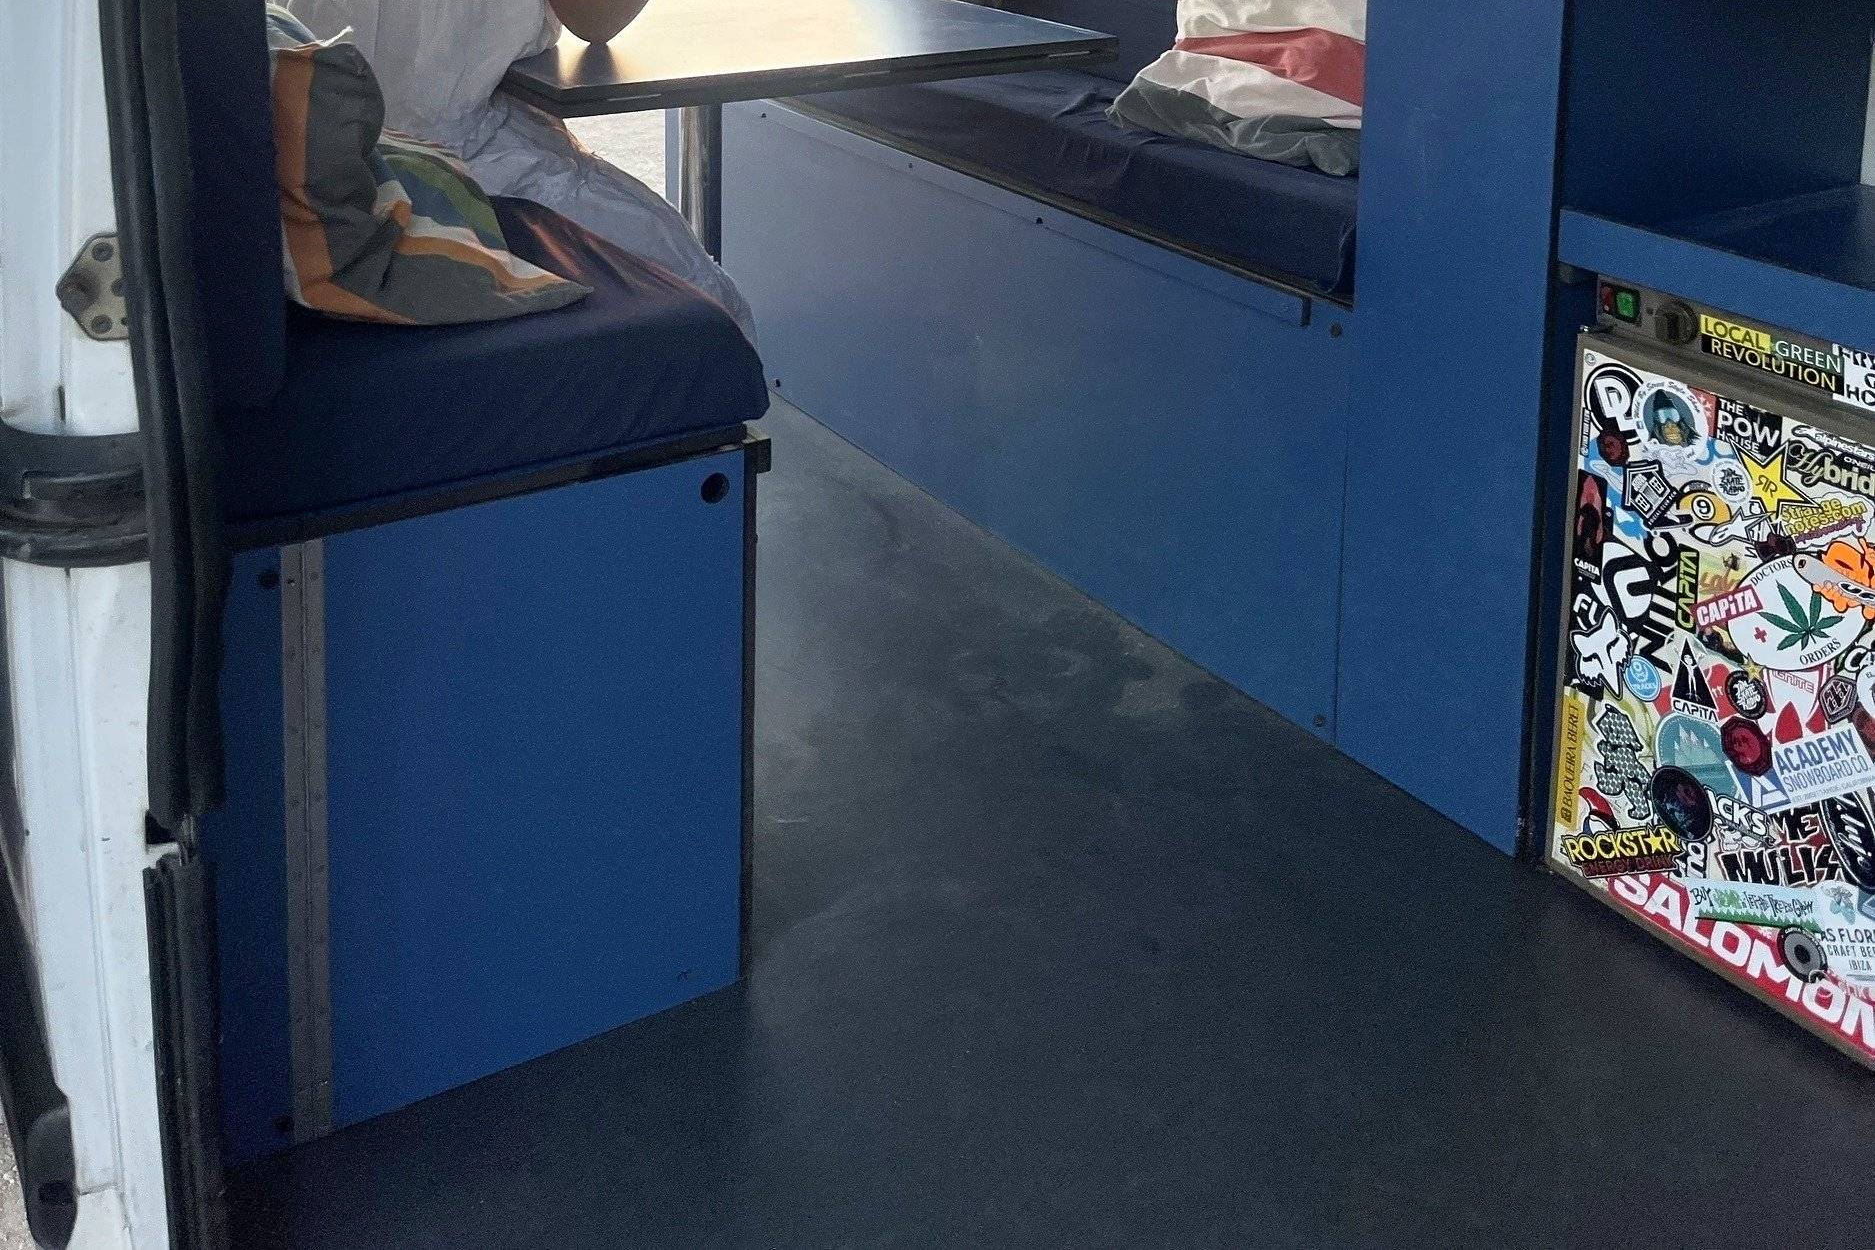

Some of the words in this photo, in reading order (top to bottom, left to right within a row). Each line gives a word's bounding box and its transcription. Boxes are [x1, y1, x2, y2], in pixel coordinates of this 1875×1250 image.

[1704, 317, 1766, 351] LOCAL
[1775, 340, 1841, 373] GREEN
[1711, 338, 1836, 392] REVOLUTION
[1719, 399, 1745, 416] THE
[1717, 410, 1780, 448] POW
[1814, 431, 1875, 461] alpinestars
[1787, 440, 1875, 496] Hybrid
[1750, 558, 1793, 587] DOCTORS
[1799, 637, 1842, 666] ORDERS
[1567, 703, 1580, 744] BERET
[1774, 729, 1860, 776] ACADEMY
[1561, 746, 1577, 809] BAQUEIRA
[1782, 758, 1854, 793] SNOWBOARD
[1583, 859, 1632, 876] ENERGY
[1636, 854, 1675, 871] DRINK
[1613, 873, 1875, 1050] SALOMON
[1826, 944, 1857, 958] CRAFT
[1849, 959, 1872, 971] IBIZA
